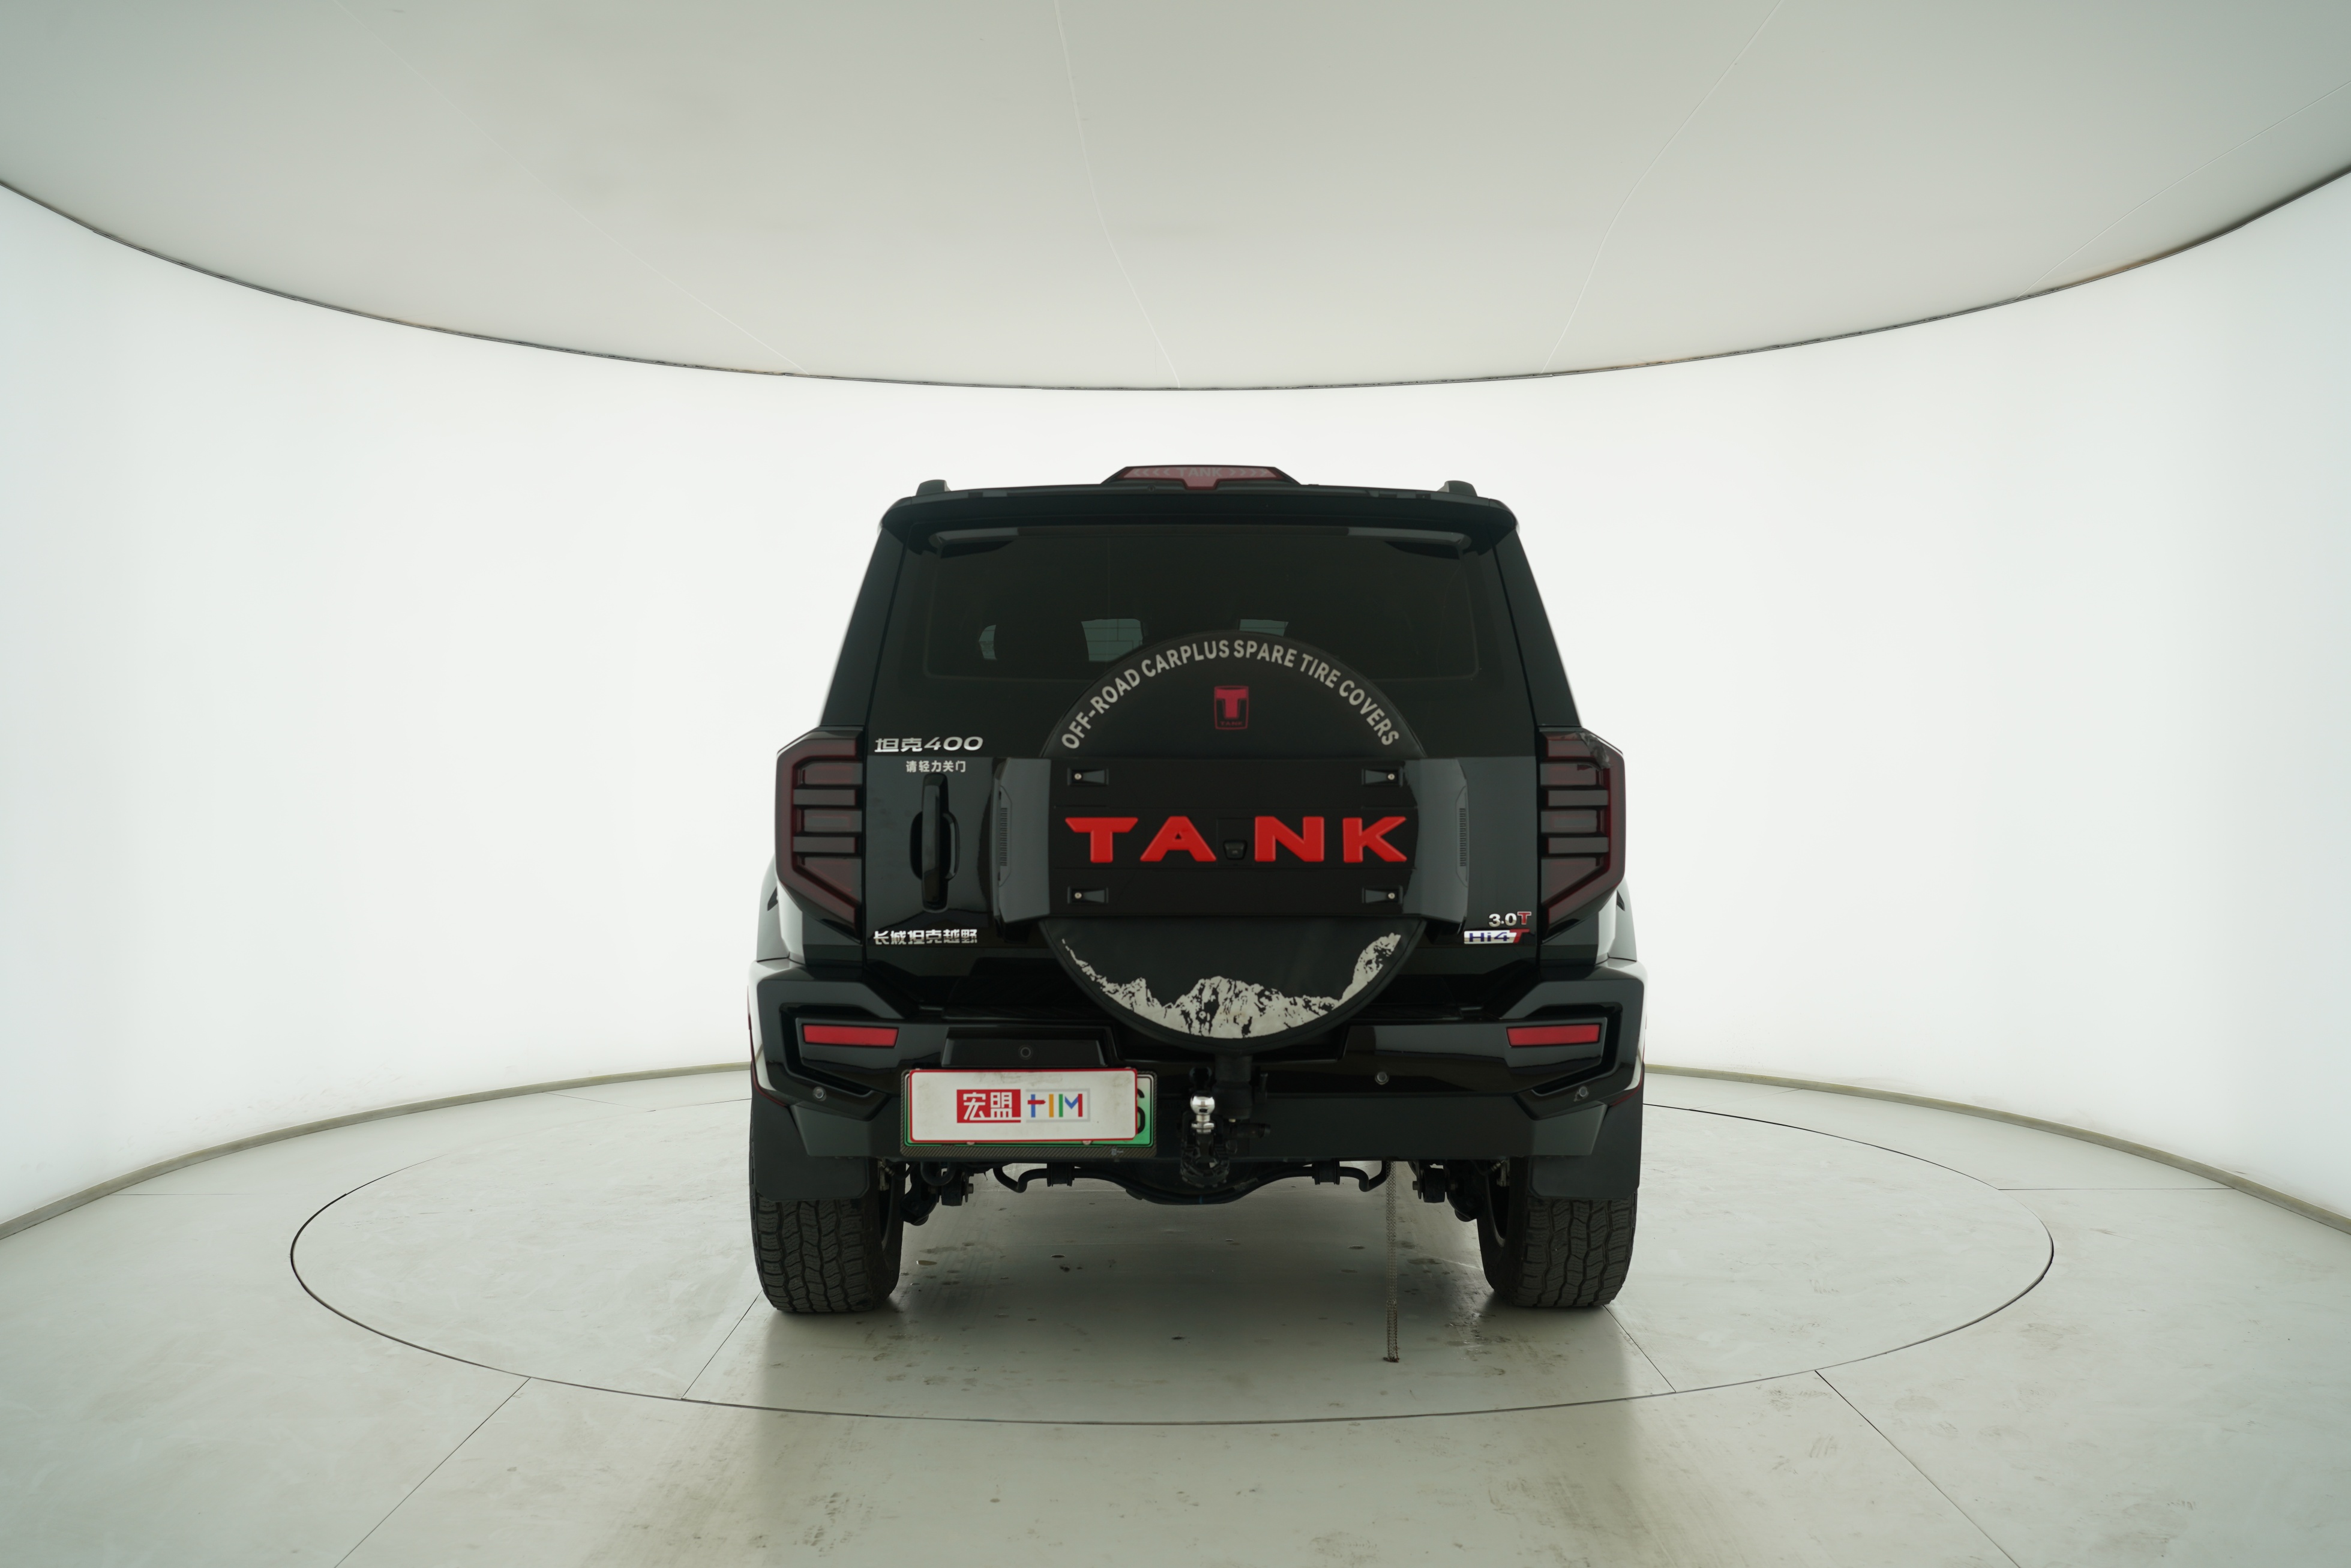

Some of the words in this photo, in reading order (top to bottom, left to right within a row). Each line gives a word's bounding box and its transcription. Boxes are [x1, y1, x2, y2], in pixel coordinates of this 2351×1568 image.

[1177, 467, 1222, 476] TANK
[1061, 668, 1141, 749] OFF-ROAD
[1141, 640, 1230, 677] CARPLUS
[1233, 640, 1297, 667] SPARE
[1300, 654, 1342, 689] TIRE
[1338, 680, 1400, 746] COVERS
[874, 736, 983, 752] 坦克400
[905, 760, 966, 773] 请轻力关门
[1065, 816, 1407, 863] TANK
[1488, 912, 1531, 927] 3.0T
[873, 929, 977, 945] 长城坦克越野
[963, 1092, 1021, 1121] 宏盟
